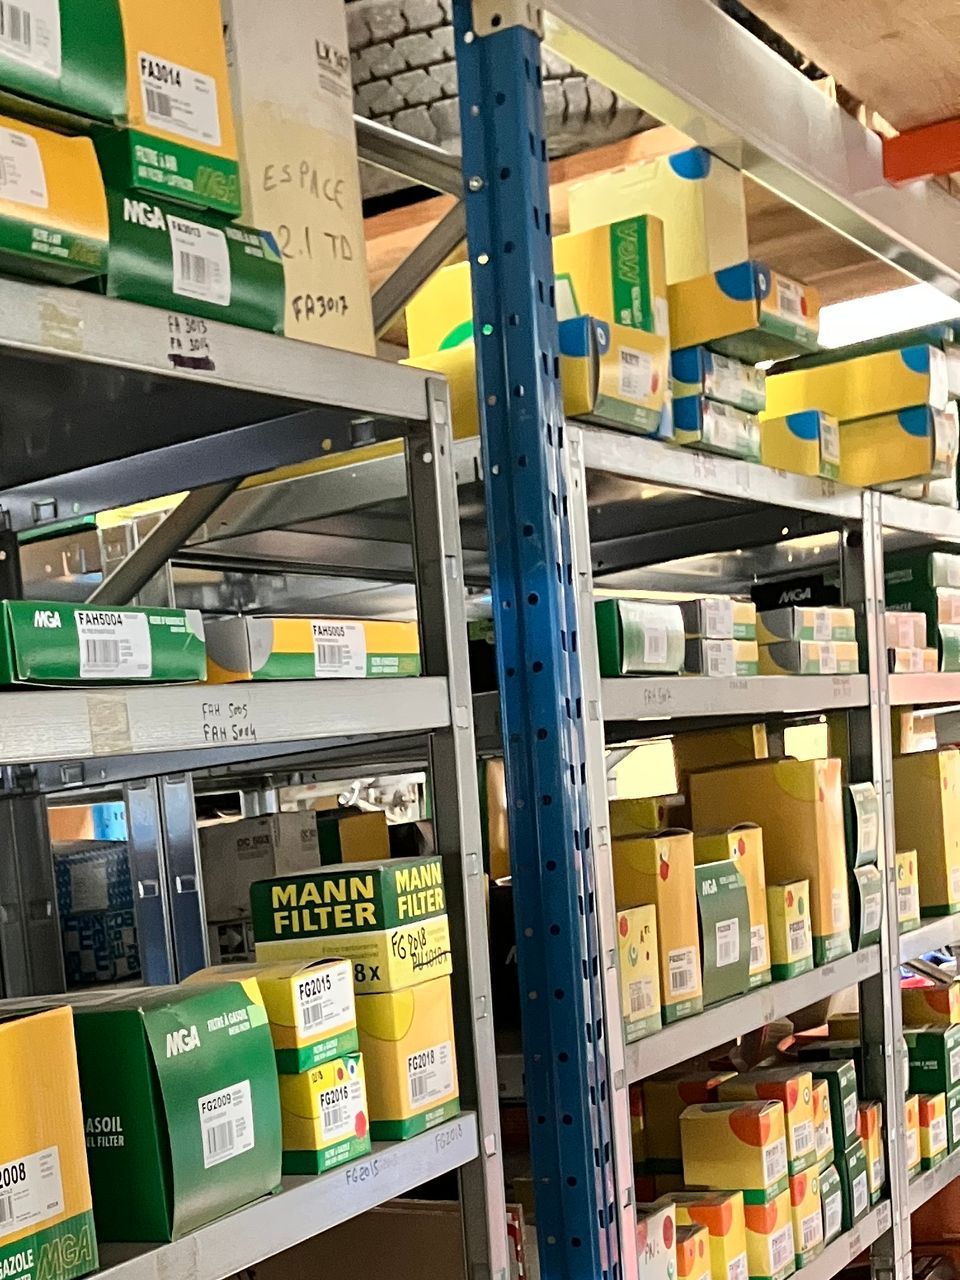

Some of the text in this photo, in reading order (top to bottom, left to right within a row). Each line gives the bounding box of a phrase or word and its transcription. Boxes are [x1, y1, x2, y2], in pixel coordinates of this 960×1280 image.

[262, 160, 345, 210] ESPACE
[123, 198, 167, 231] MGA
[33, 610, 62, 628] MGA
[77, 612, 124, 626] FAH5004
[394, 861, 443, 894] MANN
[271, 875, 375, 909] MANN
[398, 886, 445, 920] FILTER
[274, 901, 378, 935] FILTER
[354, 963, 367, 983] 8
[298, 973, 332, 1000] FG2015
[166, 1025, 201, 1058] MGA
[408, 1048, 436, 1072] FG2018
[201, 1092, 232, 1114] FG2009
[320, 1085, 349, 1108] FG2016
[86, 1115, 124, 1134] ASOIL
[97, 1134, 125, 1148] FILTER
